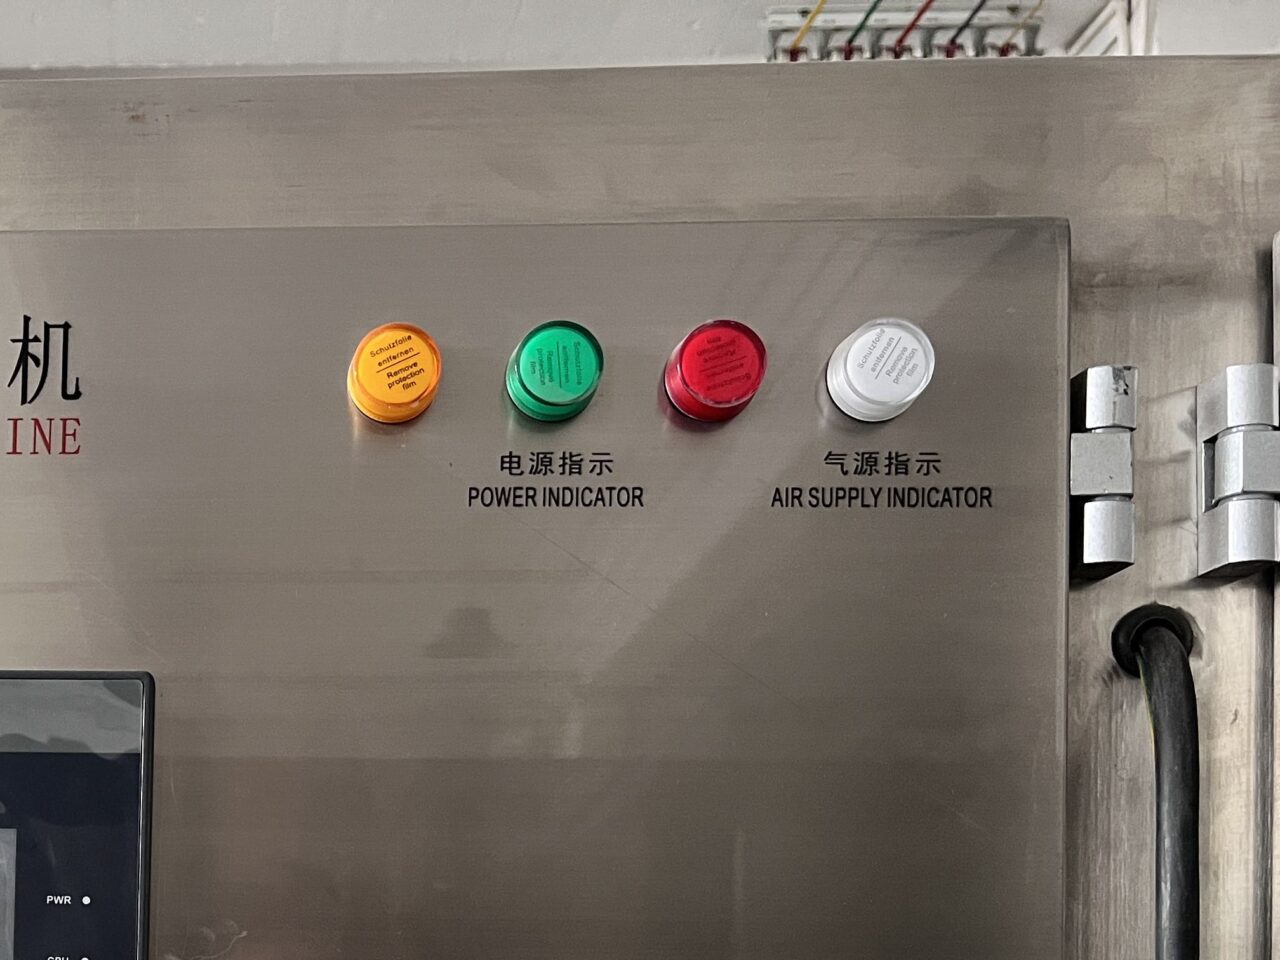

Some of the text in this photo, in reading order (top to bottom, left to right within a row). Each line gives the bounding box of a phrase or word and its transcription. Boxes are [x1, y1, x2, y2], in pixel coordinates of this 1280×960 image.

[370, 335, 412, 357] Schutzfolie
[377, 347, 414, 367] entfernen
[857, 328, 886, 369] Schutzfolie
[870, 336, 895, 373] entfernen
[386, 362, 418, 379] Remove
[885, 346, 908, 377] Remove
[892, 347, 918, 385] protection
[906, 363, 919, 377] film
[387, 367, 425, 390] protection
[402, 380, 417, 391] film
[499, 452, 614, 476] 电源指示
[823, 451, 942, 475] 气源指示
[468, 487, 644, 507] POWER INDICATOR
[771, 487, 992, 508] AIR SUPPLY INDICATOR
[46, 895, 72, 905] PWR
